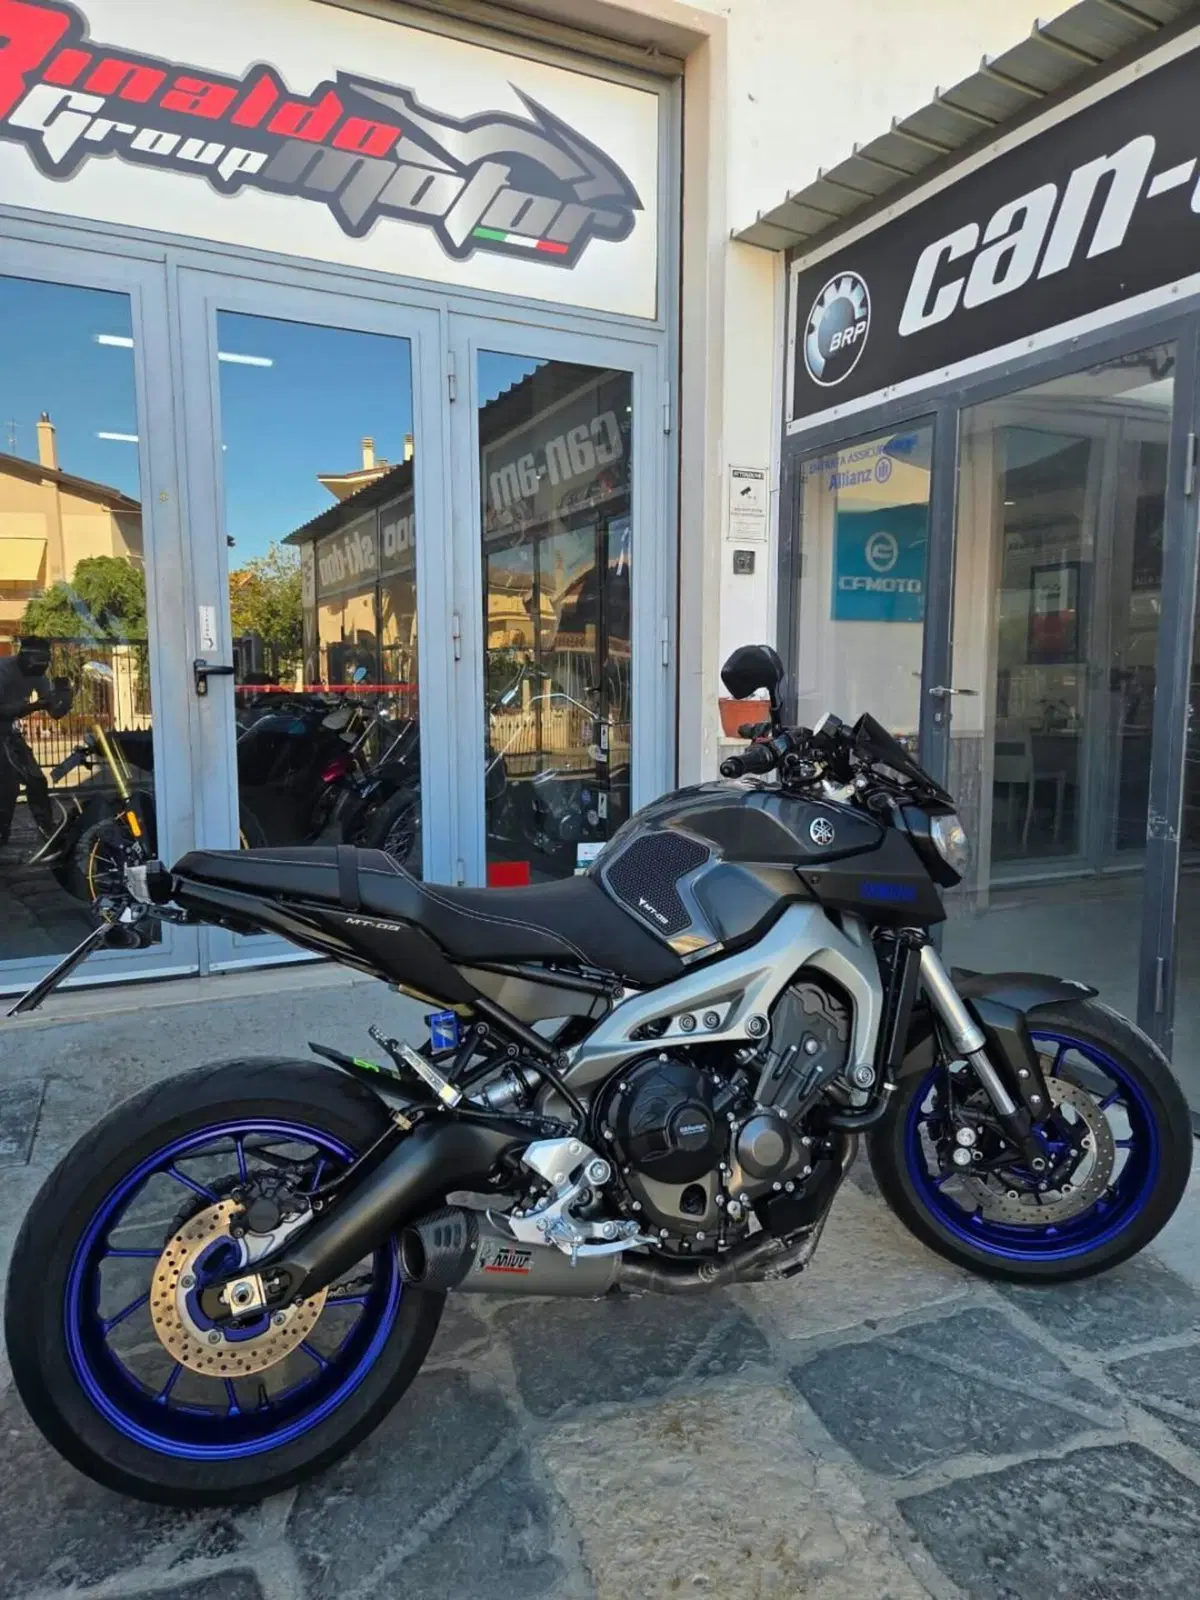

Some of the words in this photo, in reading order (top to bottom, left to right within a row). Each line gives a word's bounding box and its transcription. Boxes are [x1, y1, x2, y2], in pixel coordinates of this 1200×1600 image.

[8, 83, 269, 182] Group
[899, 134, 1200, 336] can-
[829, 320, 867, 353] BRP
[828, 467, 872, 492] Allianz
[839, 576, 921, 593] CFMOTO
[345, 917, 401, 932] MT-09
